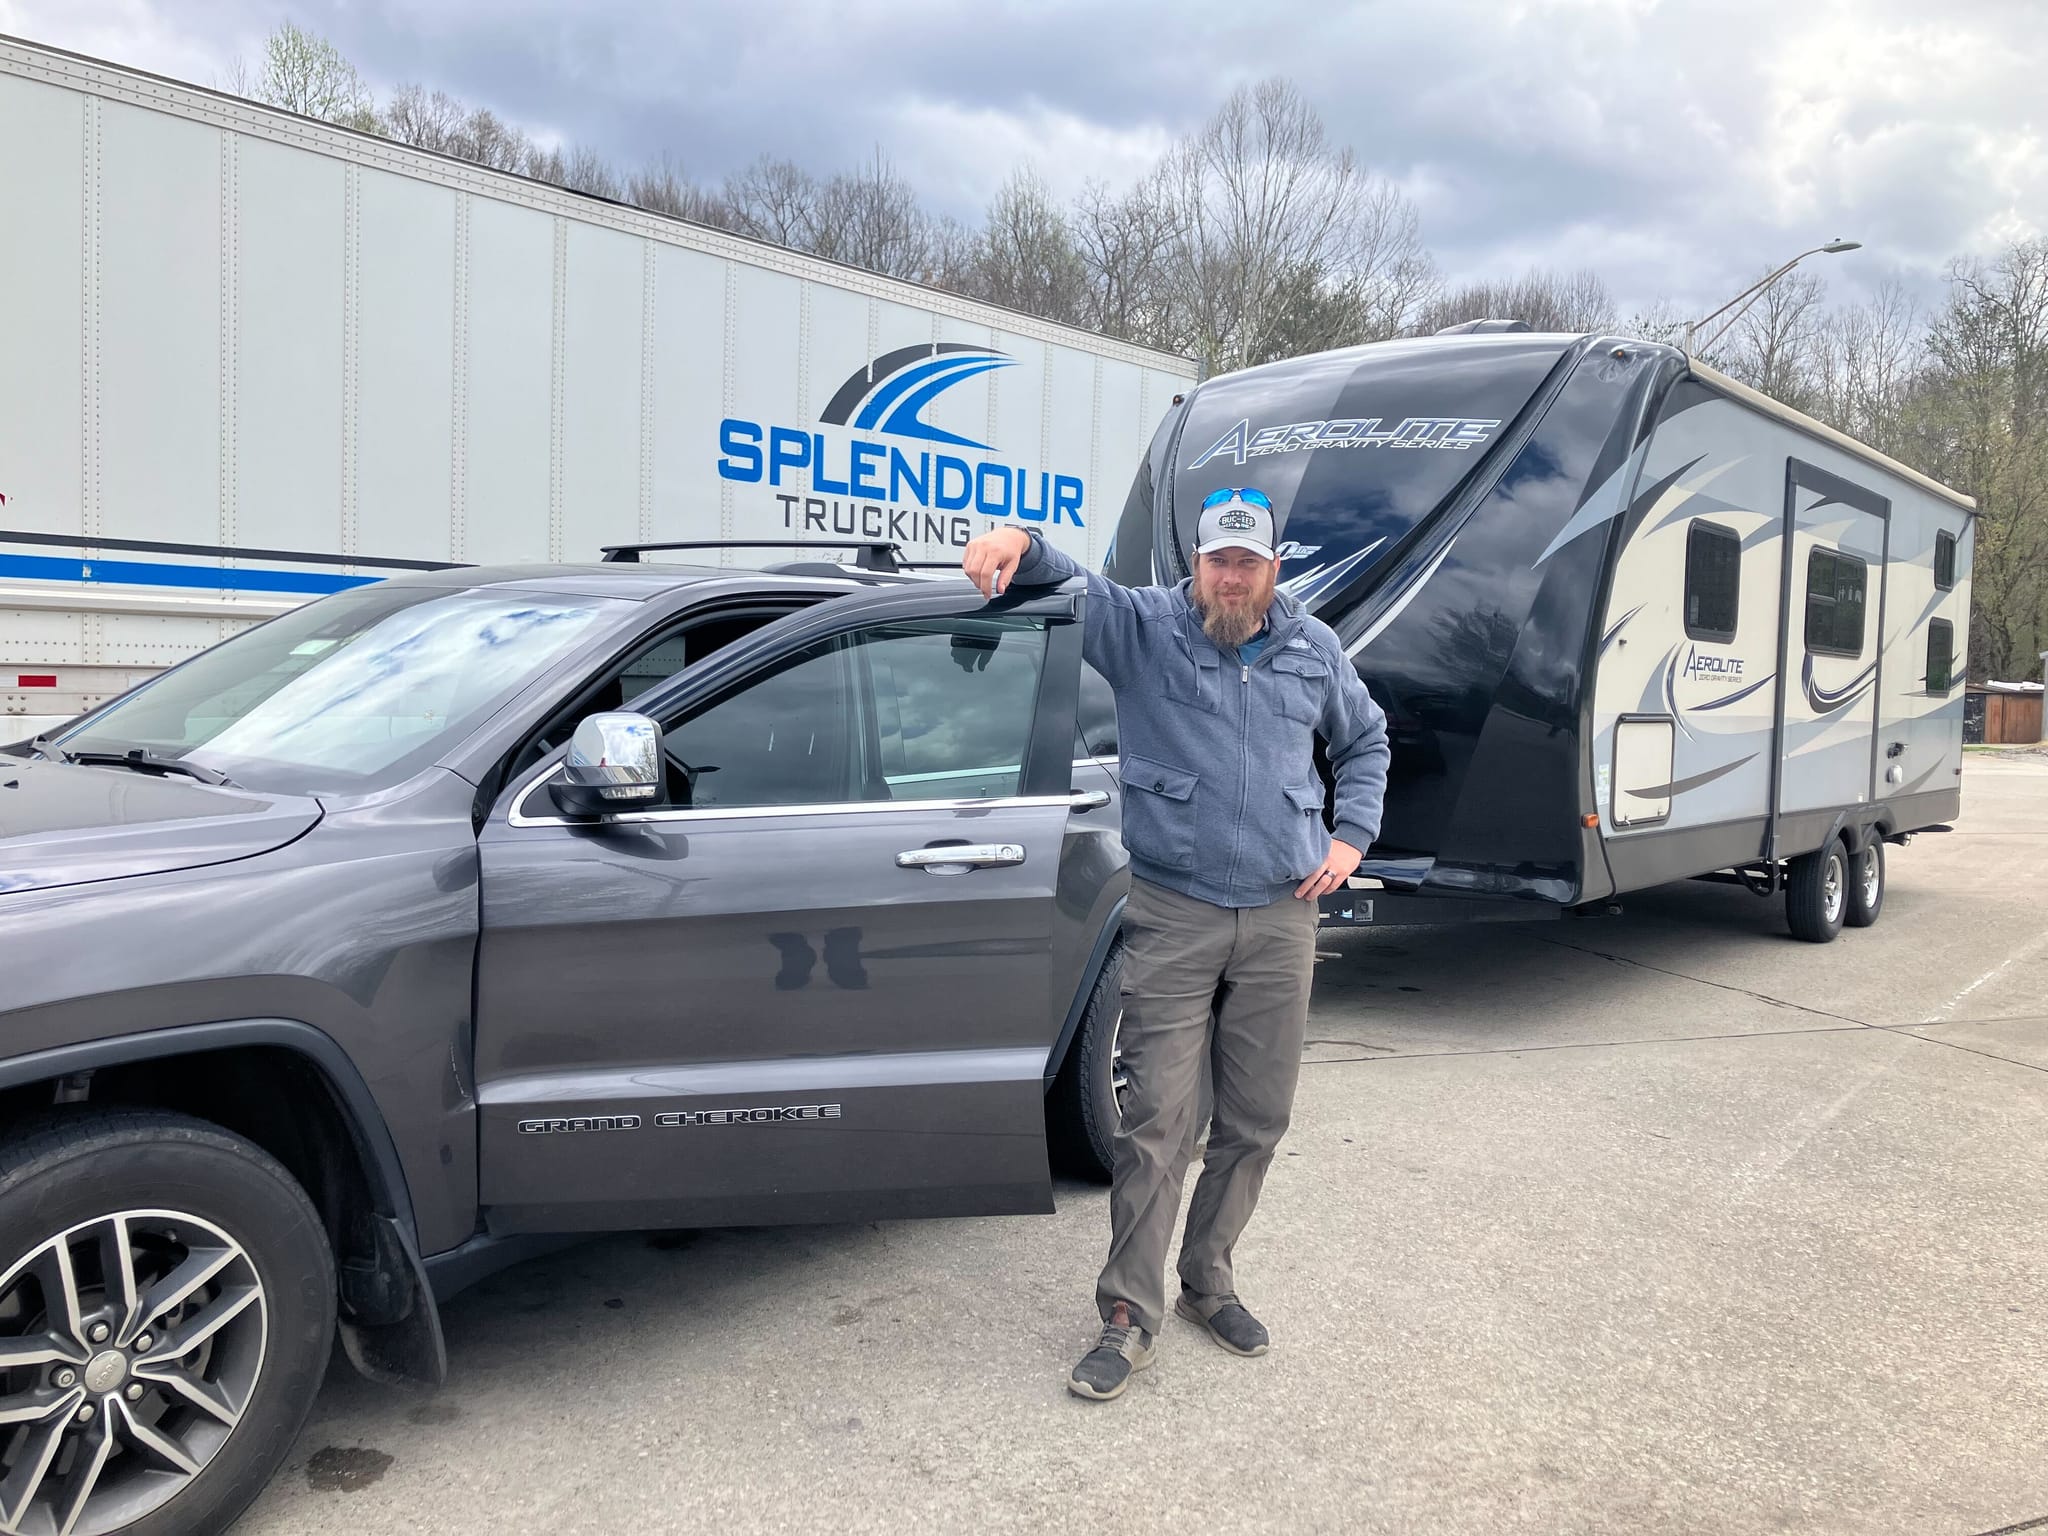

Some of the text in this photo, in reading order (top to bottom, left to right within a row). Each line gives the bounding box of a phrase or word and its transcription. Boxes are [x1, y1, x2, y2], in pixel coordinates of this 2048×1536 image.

[1187, 417, 1502, 470] AEROLITE
[1247, 439, 1473, 457] ZERO GRAVITY SERIES
[718, 418, 1086, 528] SPLENDOUR
[776, 494, 971, 547] TRUCKING
[1683, 643, 1744, 681] AEROLITE
[517, 1104, 841, 1135] GRAND CHEROKEE
